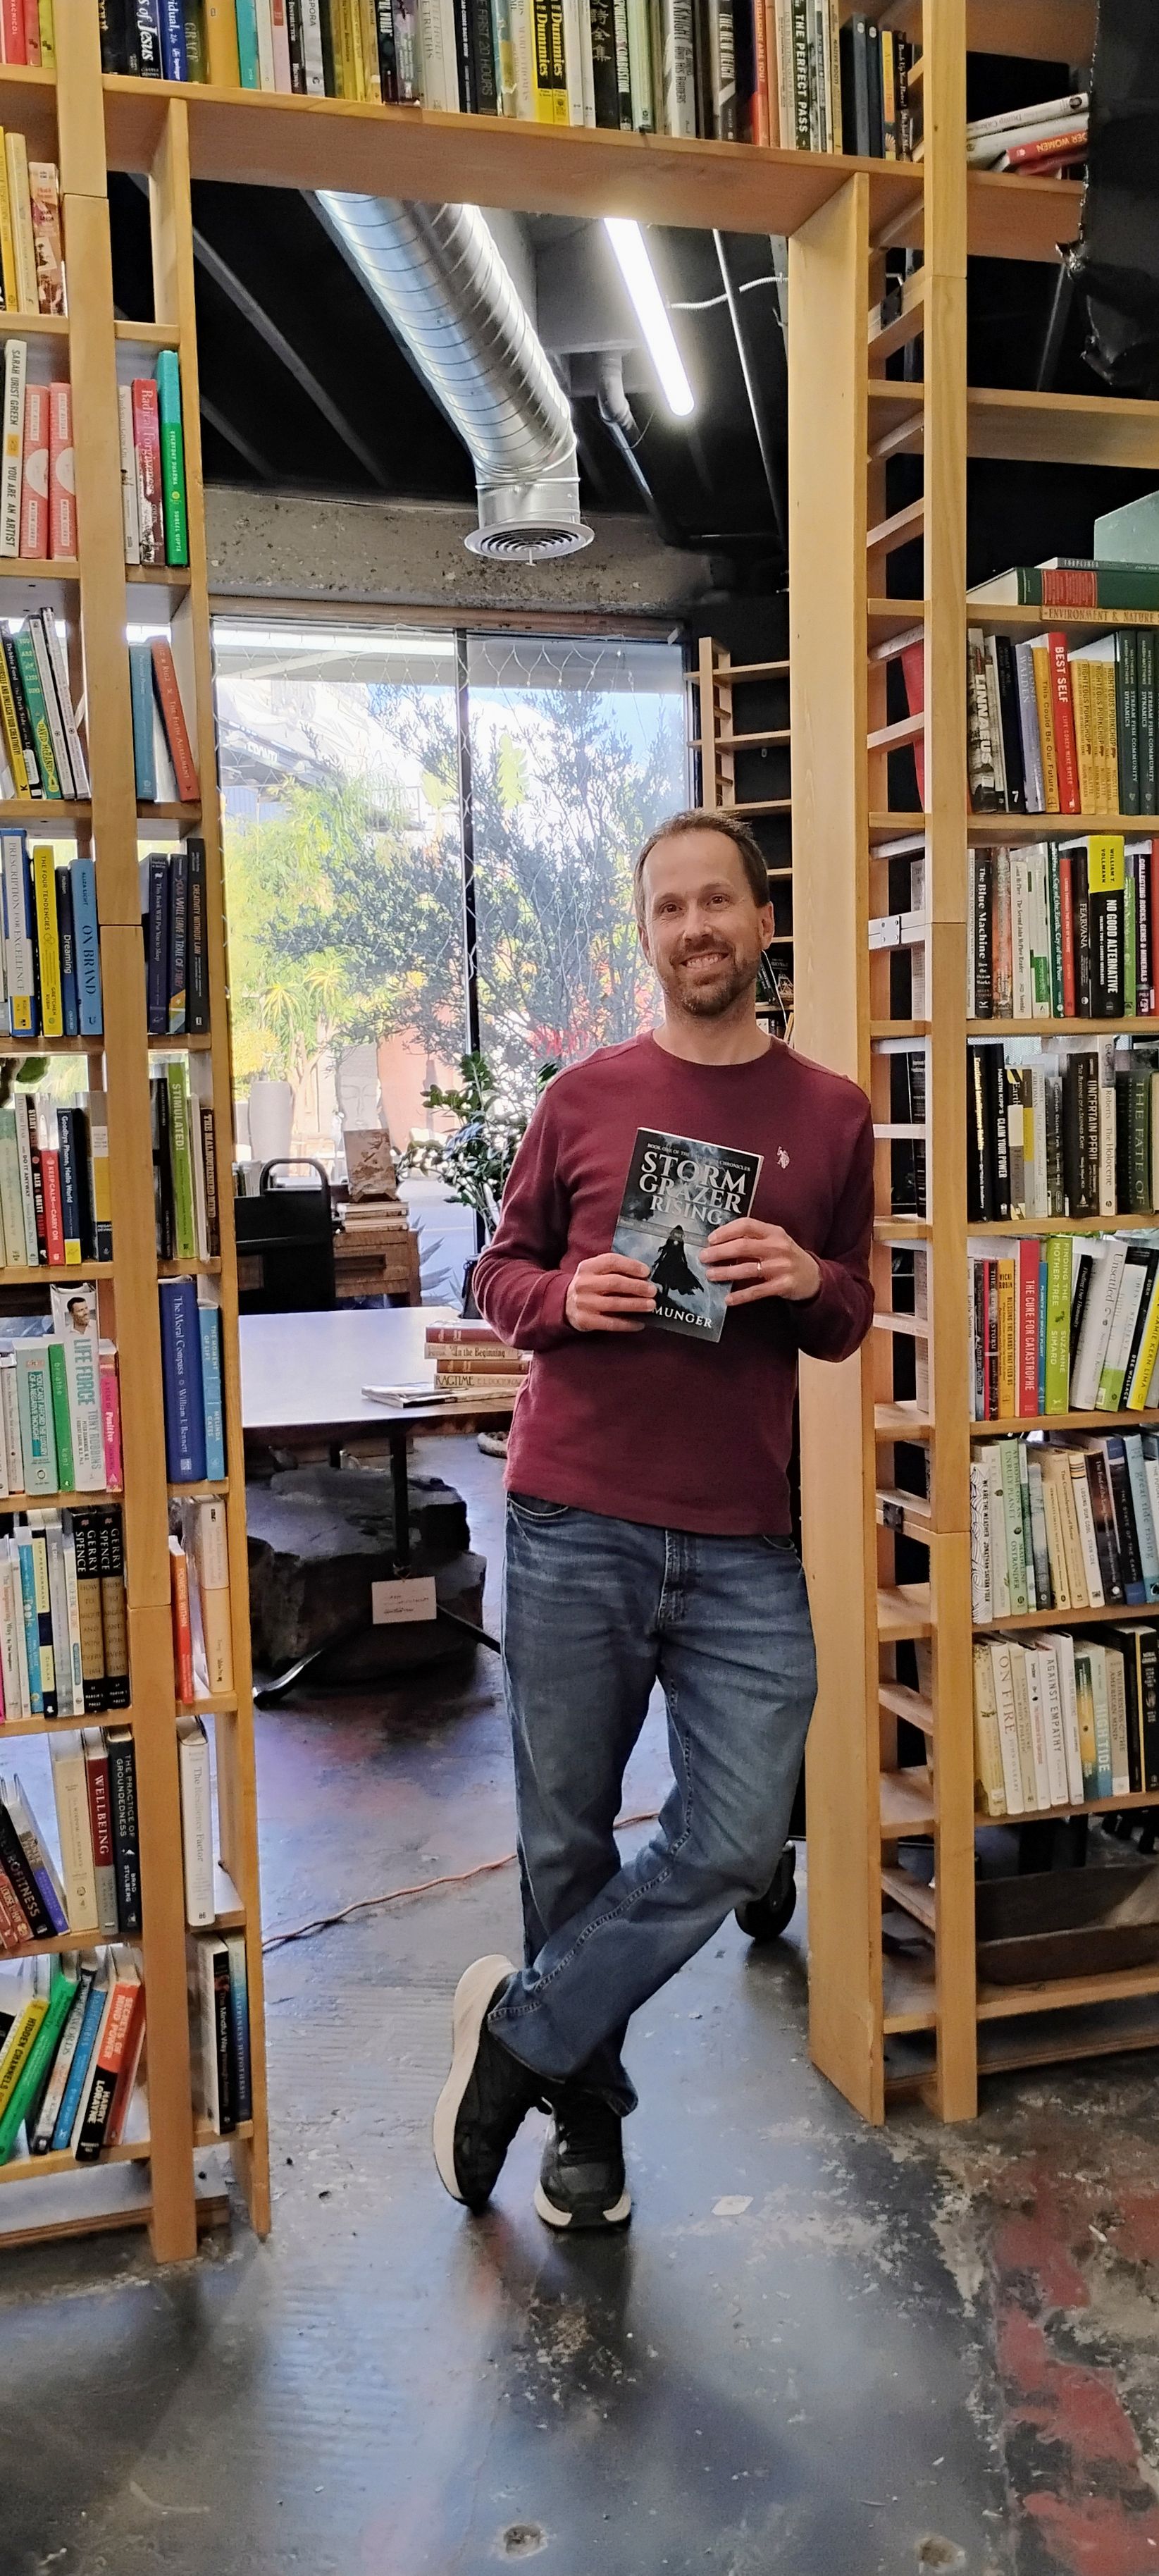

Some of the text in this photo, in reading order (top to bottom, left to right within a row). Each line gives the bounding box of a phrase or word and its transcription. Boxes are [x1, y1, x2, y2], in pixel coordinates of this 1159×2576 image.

[136, 8, 150, 25] of
[719, 13, 733, 28] THE
[138, 21, 157, 61] Jesus
[477, 8, 492, 95] FIRST 20 HOURS
[537, 13, 550, 76] Dummies
[551, 13, 564, 76] Dummies
[795, 15, 808, 133] THE PERFECT PASS
[1036, 133, 1070, 153] WOMEN
[10, 350, 20, 426] SARAH URIST GREEN
[140, 389, 158, 495] Radical Forgiveness
[5, 466, 17, 547] YOU ARE AN ARTIST
[1048, 610, 1108, 621] ENVIRONMENT
[1123, 611, 1153, 622] NATURE
[6, 643, 19, 680] Debbie Ford
[1055, 646, 1068, 703] BEST SELF
[15, 696, 24, 711] Dark
[975, 674, 992, 764] LINNAEUS
[38, 724, 47, 742] DAVID
[169, 701, 178, 713] THE
[175, 738, 189, 778] AGREEMENT
[1045, 731, 1052, 741] Be
[9, 842, 19, 909] PRESCRIPTION
[977, 884, 987, 909] Blue
[42, 890, 51, 930] TENDENCIES
[192, 885, 201, 914] CREATIVITY
[63, 935, 72, 973] Dreaming
[979, 913, 988, 959] Machine
[1106, 900, 1117, 993] NO GOOD ALTERNATIVE
[13, 930, 25, 991] EXCELLENCE
[82, 925, 96, 994] ON BRAND
[61, 1116, 72, 1143] Goodbye
[173, 1083, 185, 1151] STIMULATED!
[997, 1118, 1007, 1178] CLAIM YOUR POWER
[1135, 1079, 1145, 1204] THE FATE OF
[204, 1114, 216, 1218] THE MALNOURISHED MIND
[640, 1151, 747, 1195] STORM
[639, 1173, 742, 1214] GRAZER
[650, 1195, 723, 1226] RISING
[1105, 1253, 1123, 1302] Unsettled
[173, 1296, 185, 1374] The Moral Compass
[463, 1348, 473, 1357] the
[475, 1348, 506, 1358] Beginning
[1025, 1280, 1034, 1391] THE CURE FOR CATASTROPHE
[1146, 1343, 1155, 1366] KERN
[74, 1338, 95, 1406] LIFE FORCE
[435, 1376, 475, 1386] RAGTIME
[1123, 1370, 1134, 1400] WALLACE
[1141, 1369, 1151, 1388] LIMA
[1135, 1472, 1146, 1498] great
[1143, 1528, 1153, 1560] rising
[75, 1532, 86, 1572] SPENCE
[87, 1530, 98, 1572] GERRY
[100, 1529, 110, 1570] SPENCE
[111, 1528, 120, 1569] GERRY
[998, 1656, 1016, 1734] ON FIRE
[1047, 1659, 1061, 1752] AGAINST EMPATHY
[94, 1775, 109, 1854] WELLBEING
[116, 1758, 128, 1837] GROUNDEDNESS
[125, 1776, 134, 1823] PRACTICE
[128, 1825, 135, 1837] OF
[123, 1865, 132, 1903] STULBERG
[103, 1995, 125, 2059] MIND POWER
[115, 2043, 125, 2057] OF
[87, 2080, 106, 2124] LORAYNE
[97, 2090, 111, 2124] HARRY
